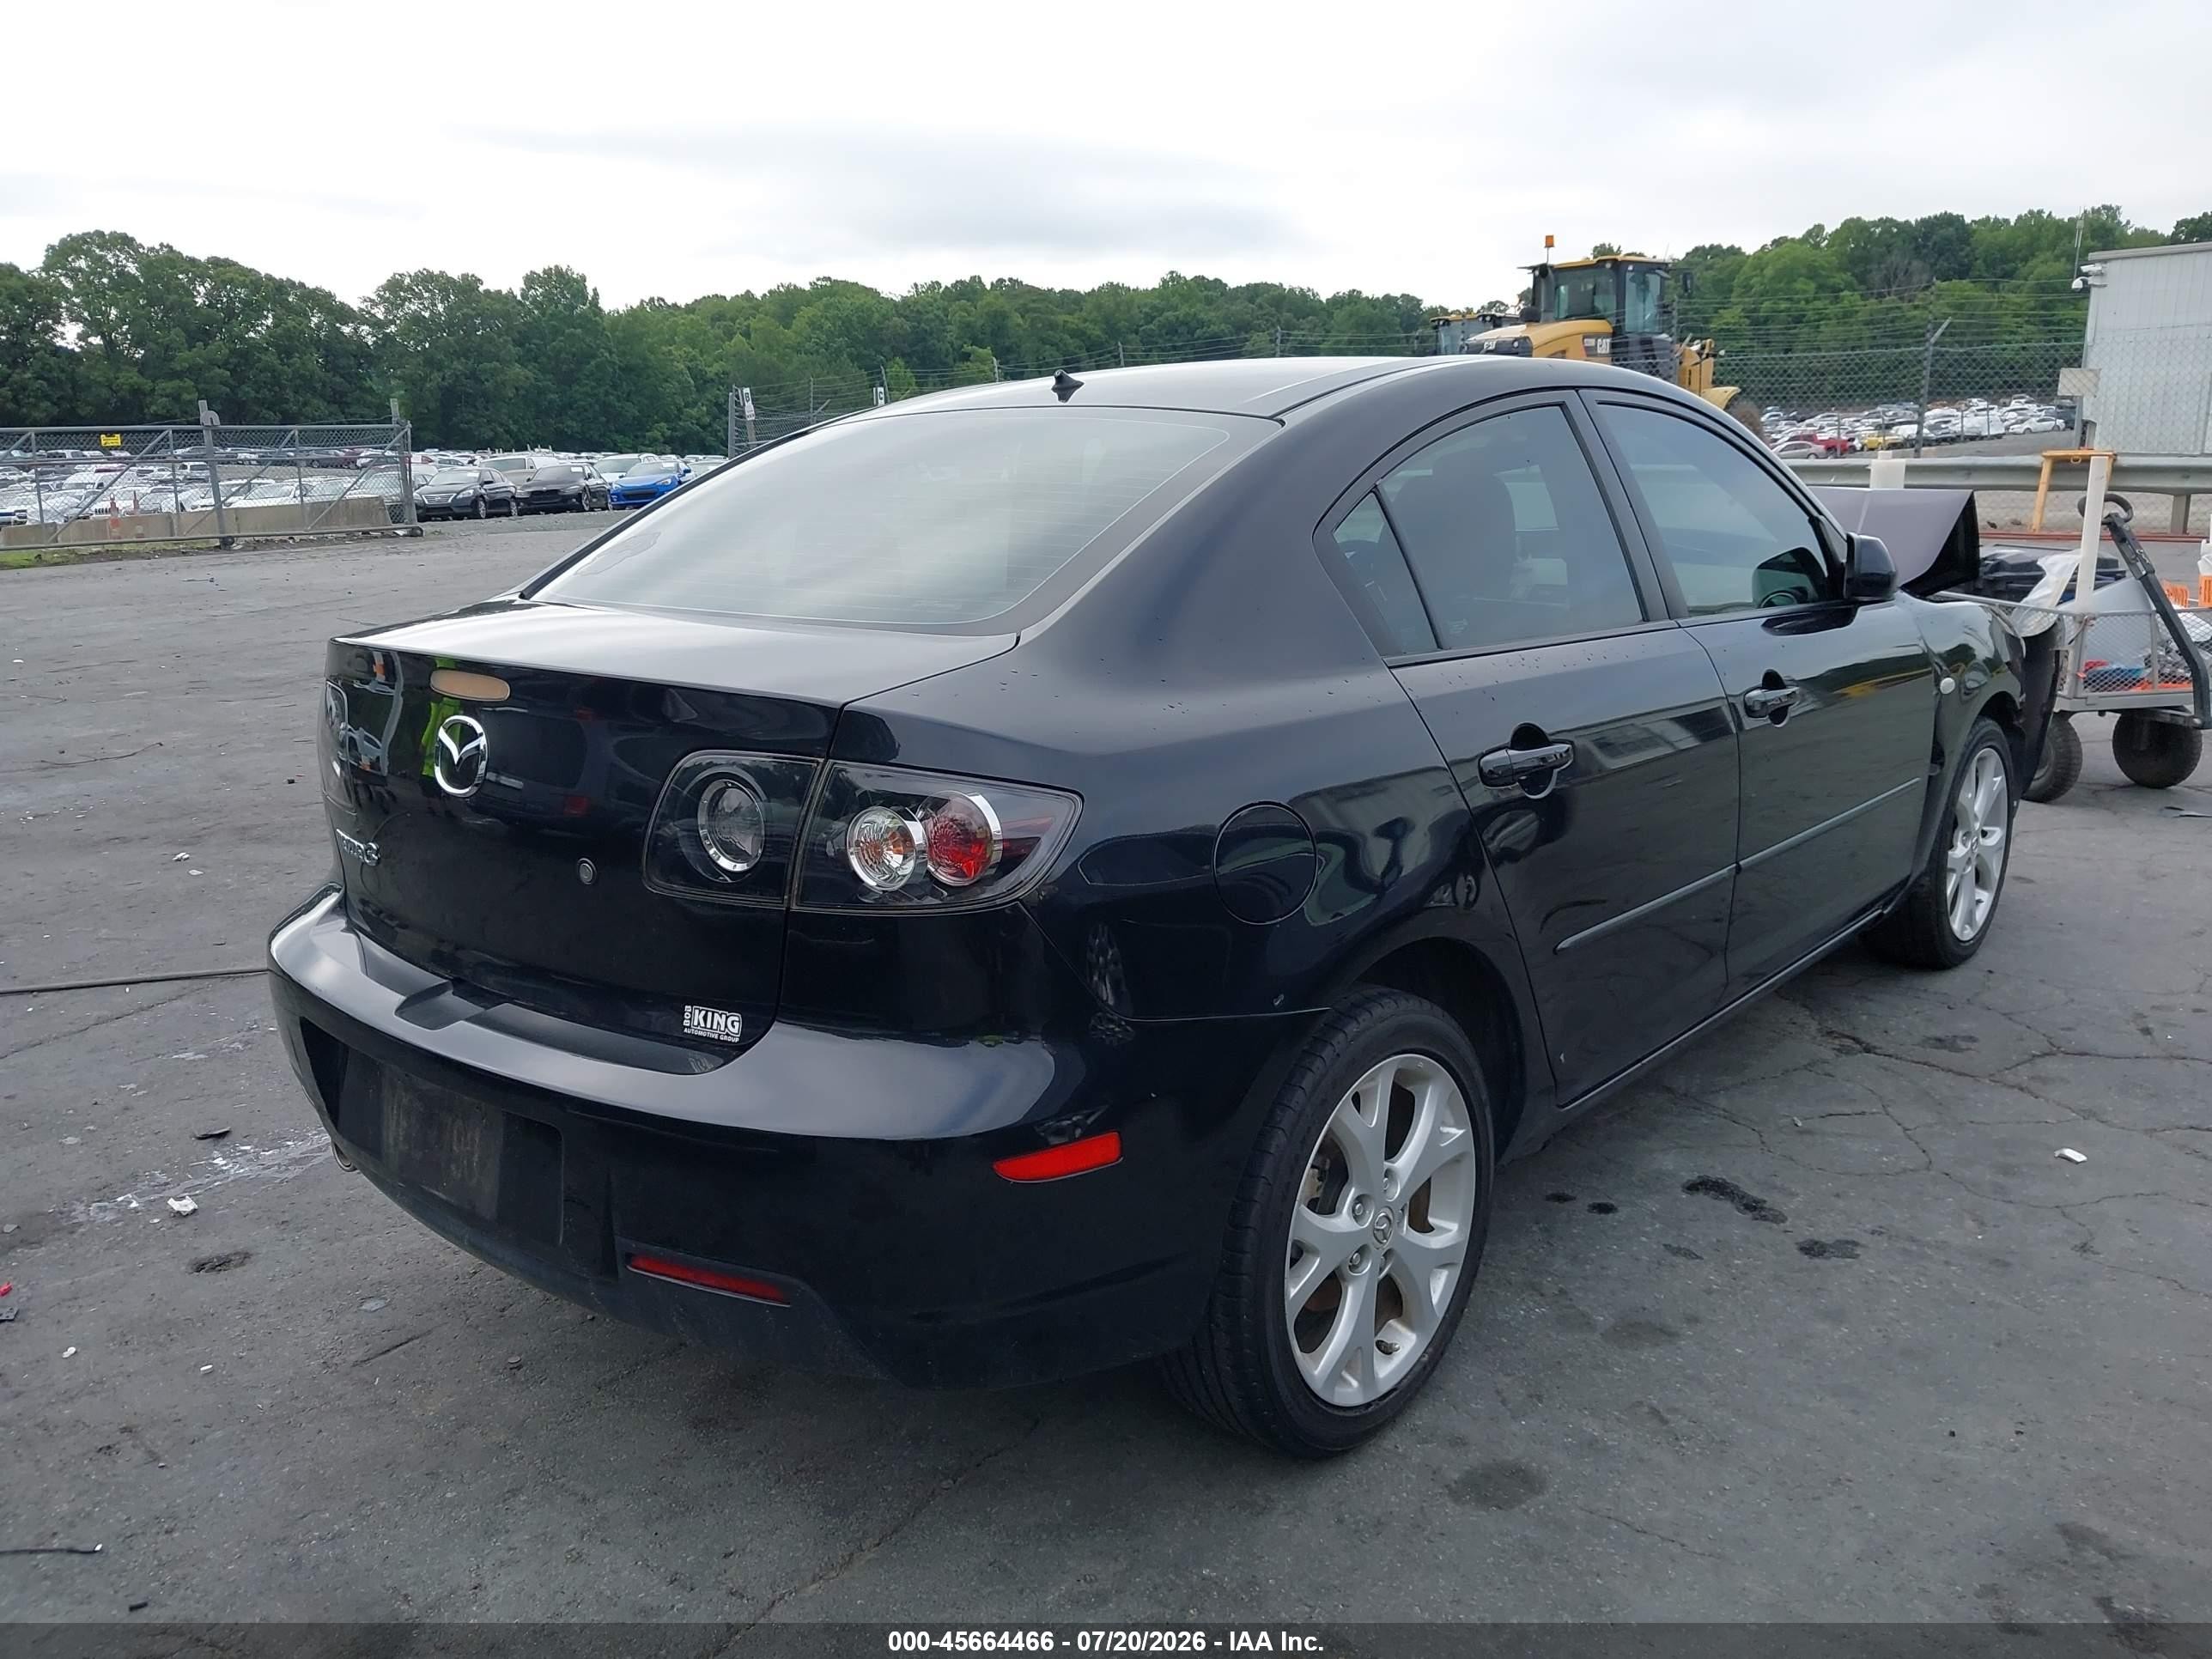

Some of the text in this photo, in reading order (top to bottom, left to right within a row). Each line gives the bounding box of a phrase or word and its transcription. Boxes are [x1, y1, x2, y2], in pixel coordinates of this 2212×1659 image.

[1597, 337, 1610, 354] CAT
[878, 391, 884, 400] C
[683, 1005, 692, 1027] BOB
[692, 1008, 740, 1035] KING
[684, 1027, 739, 1043] AUTOMOTIVE GROUP
